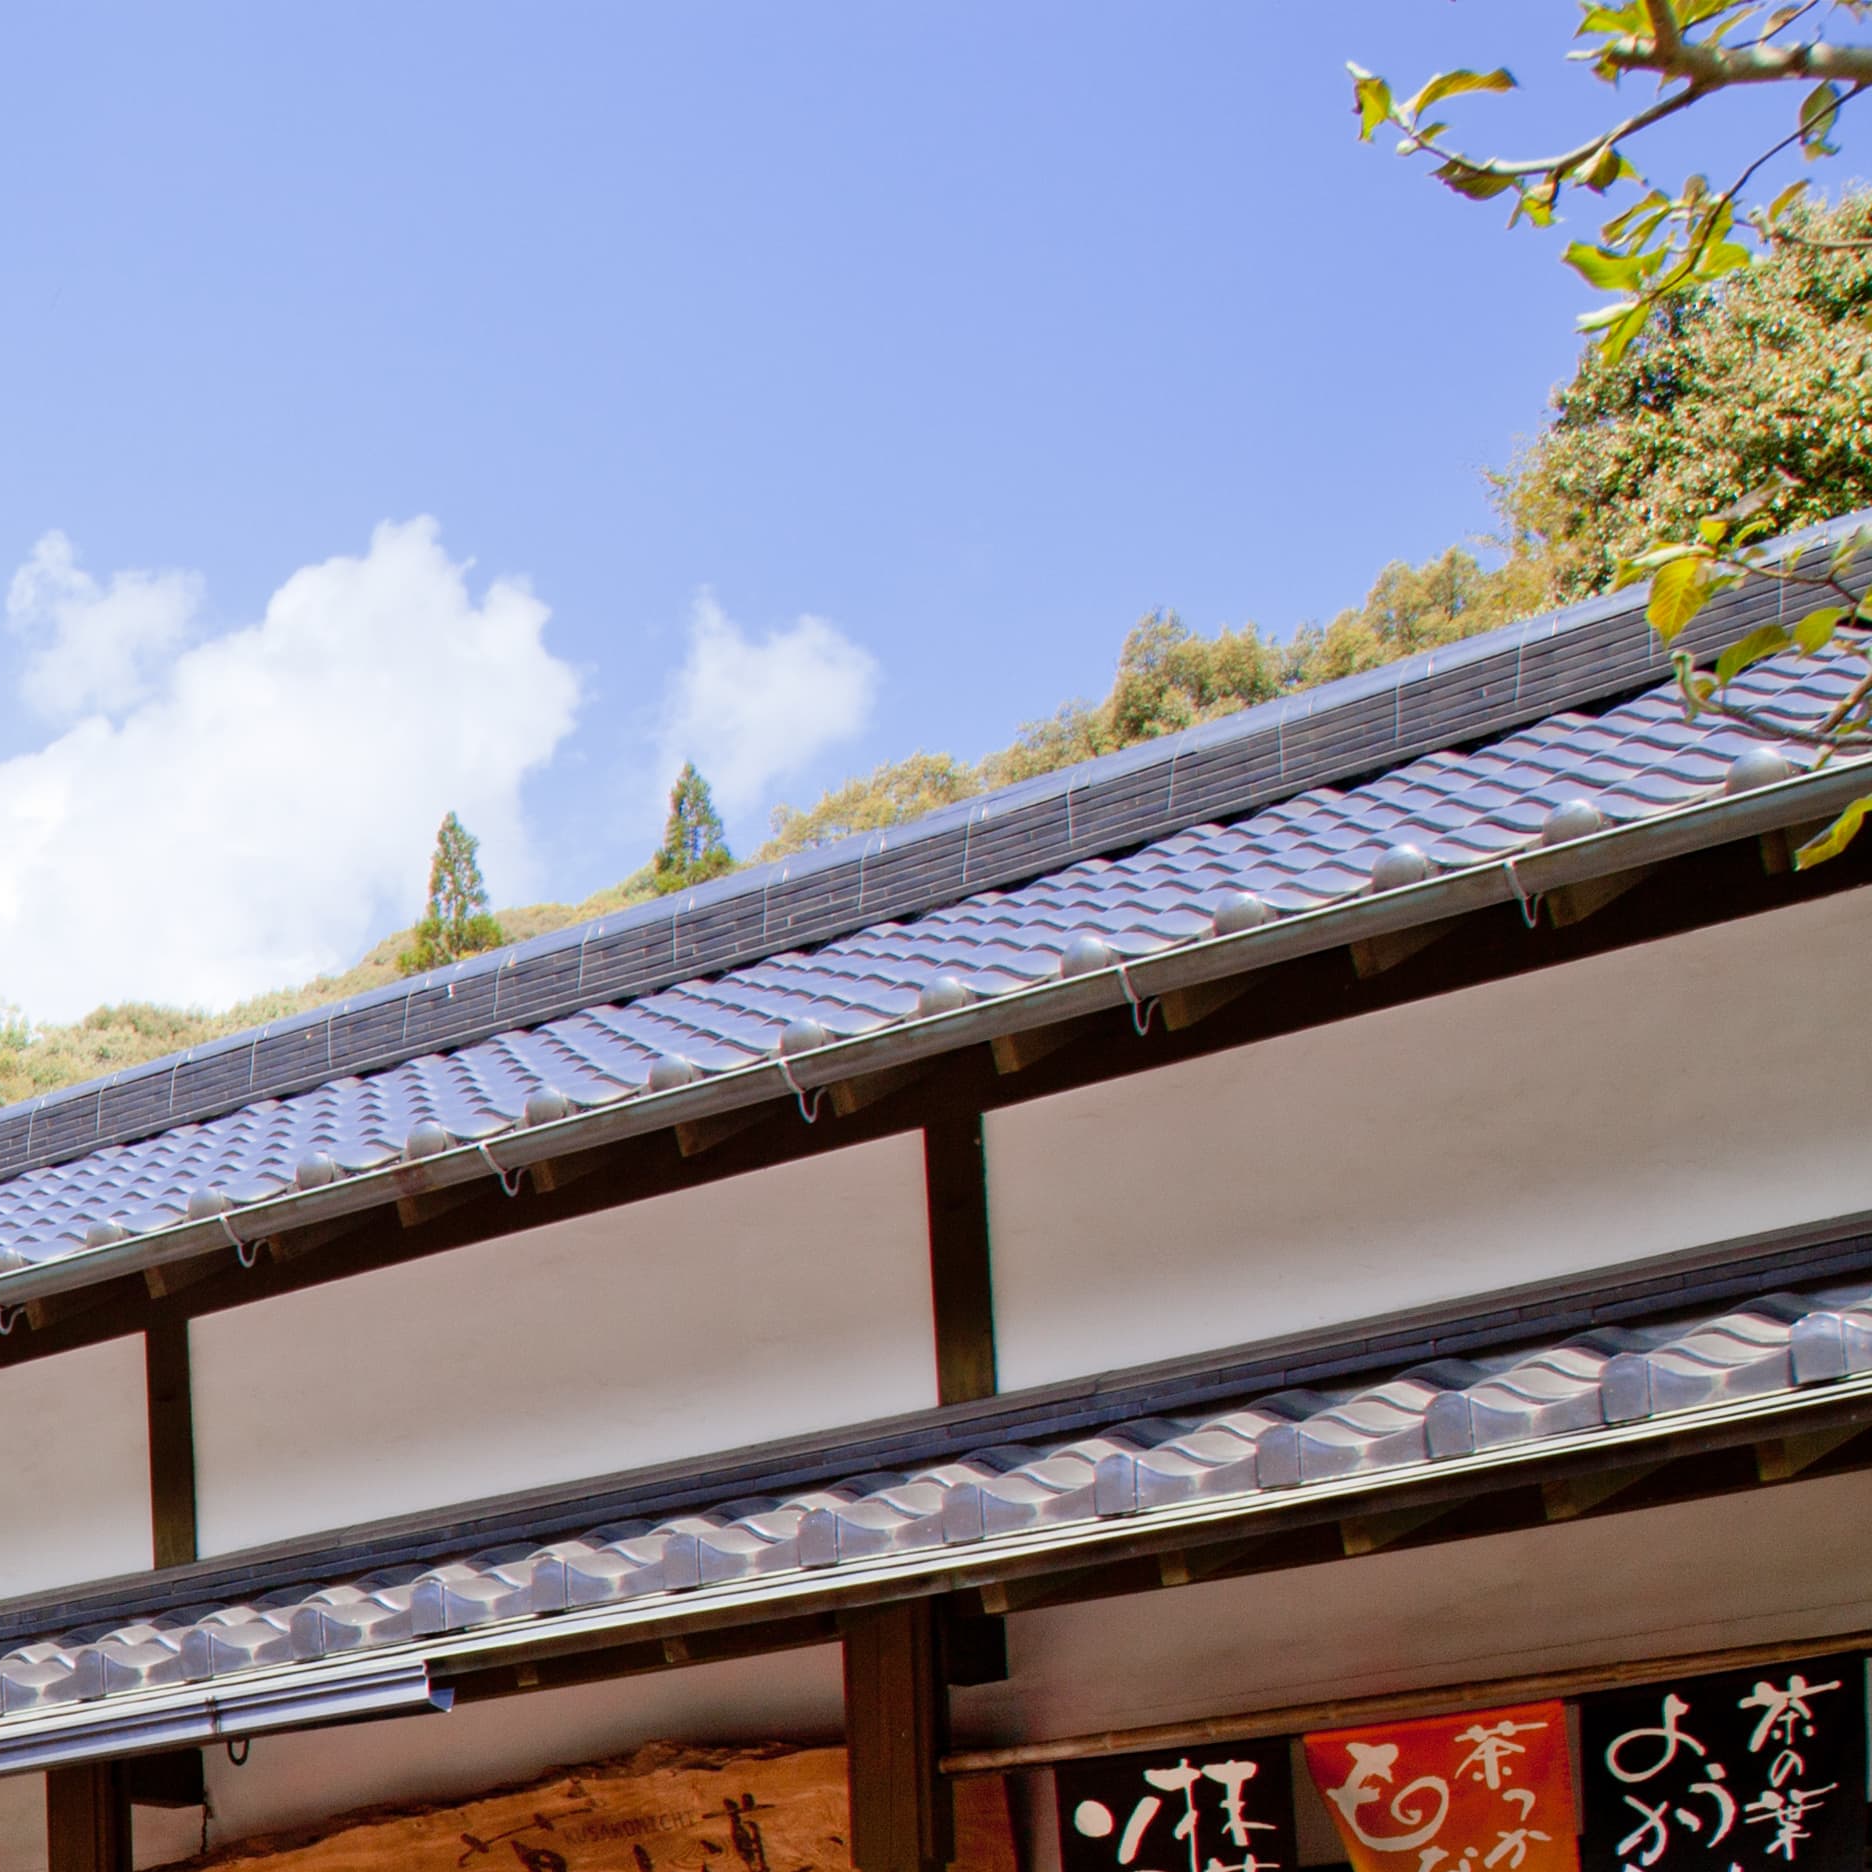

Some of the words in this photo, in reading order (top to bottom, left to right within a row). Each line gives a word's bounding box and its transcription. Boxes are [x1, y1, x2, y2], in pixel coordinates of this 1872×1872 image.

[1740, 1675, 1842, 1860] 茶の葉
[562, 1810, 696, 1845] KUSAKOMICHI
